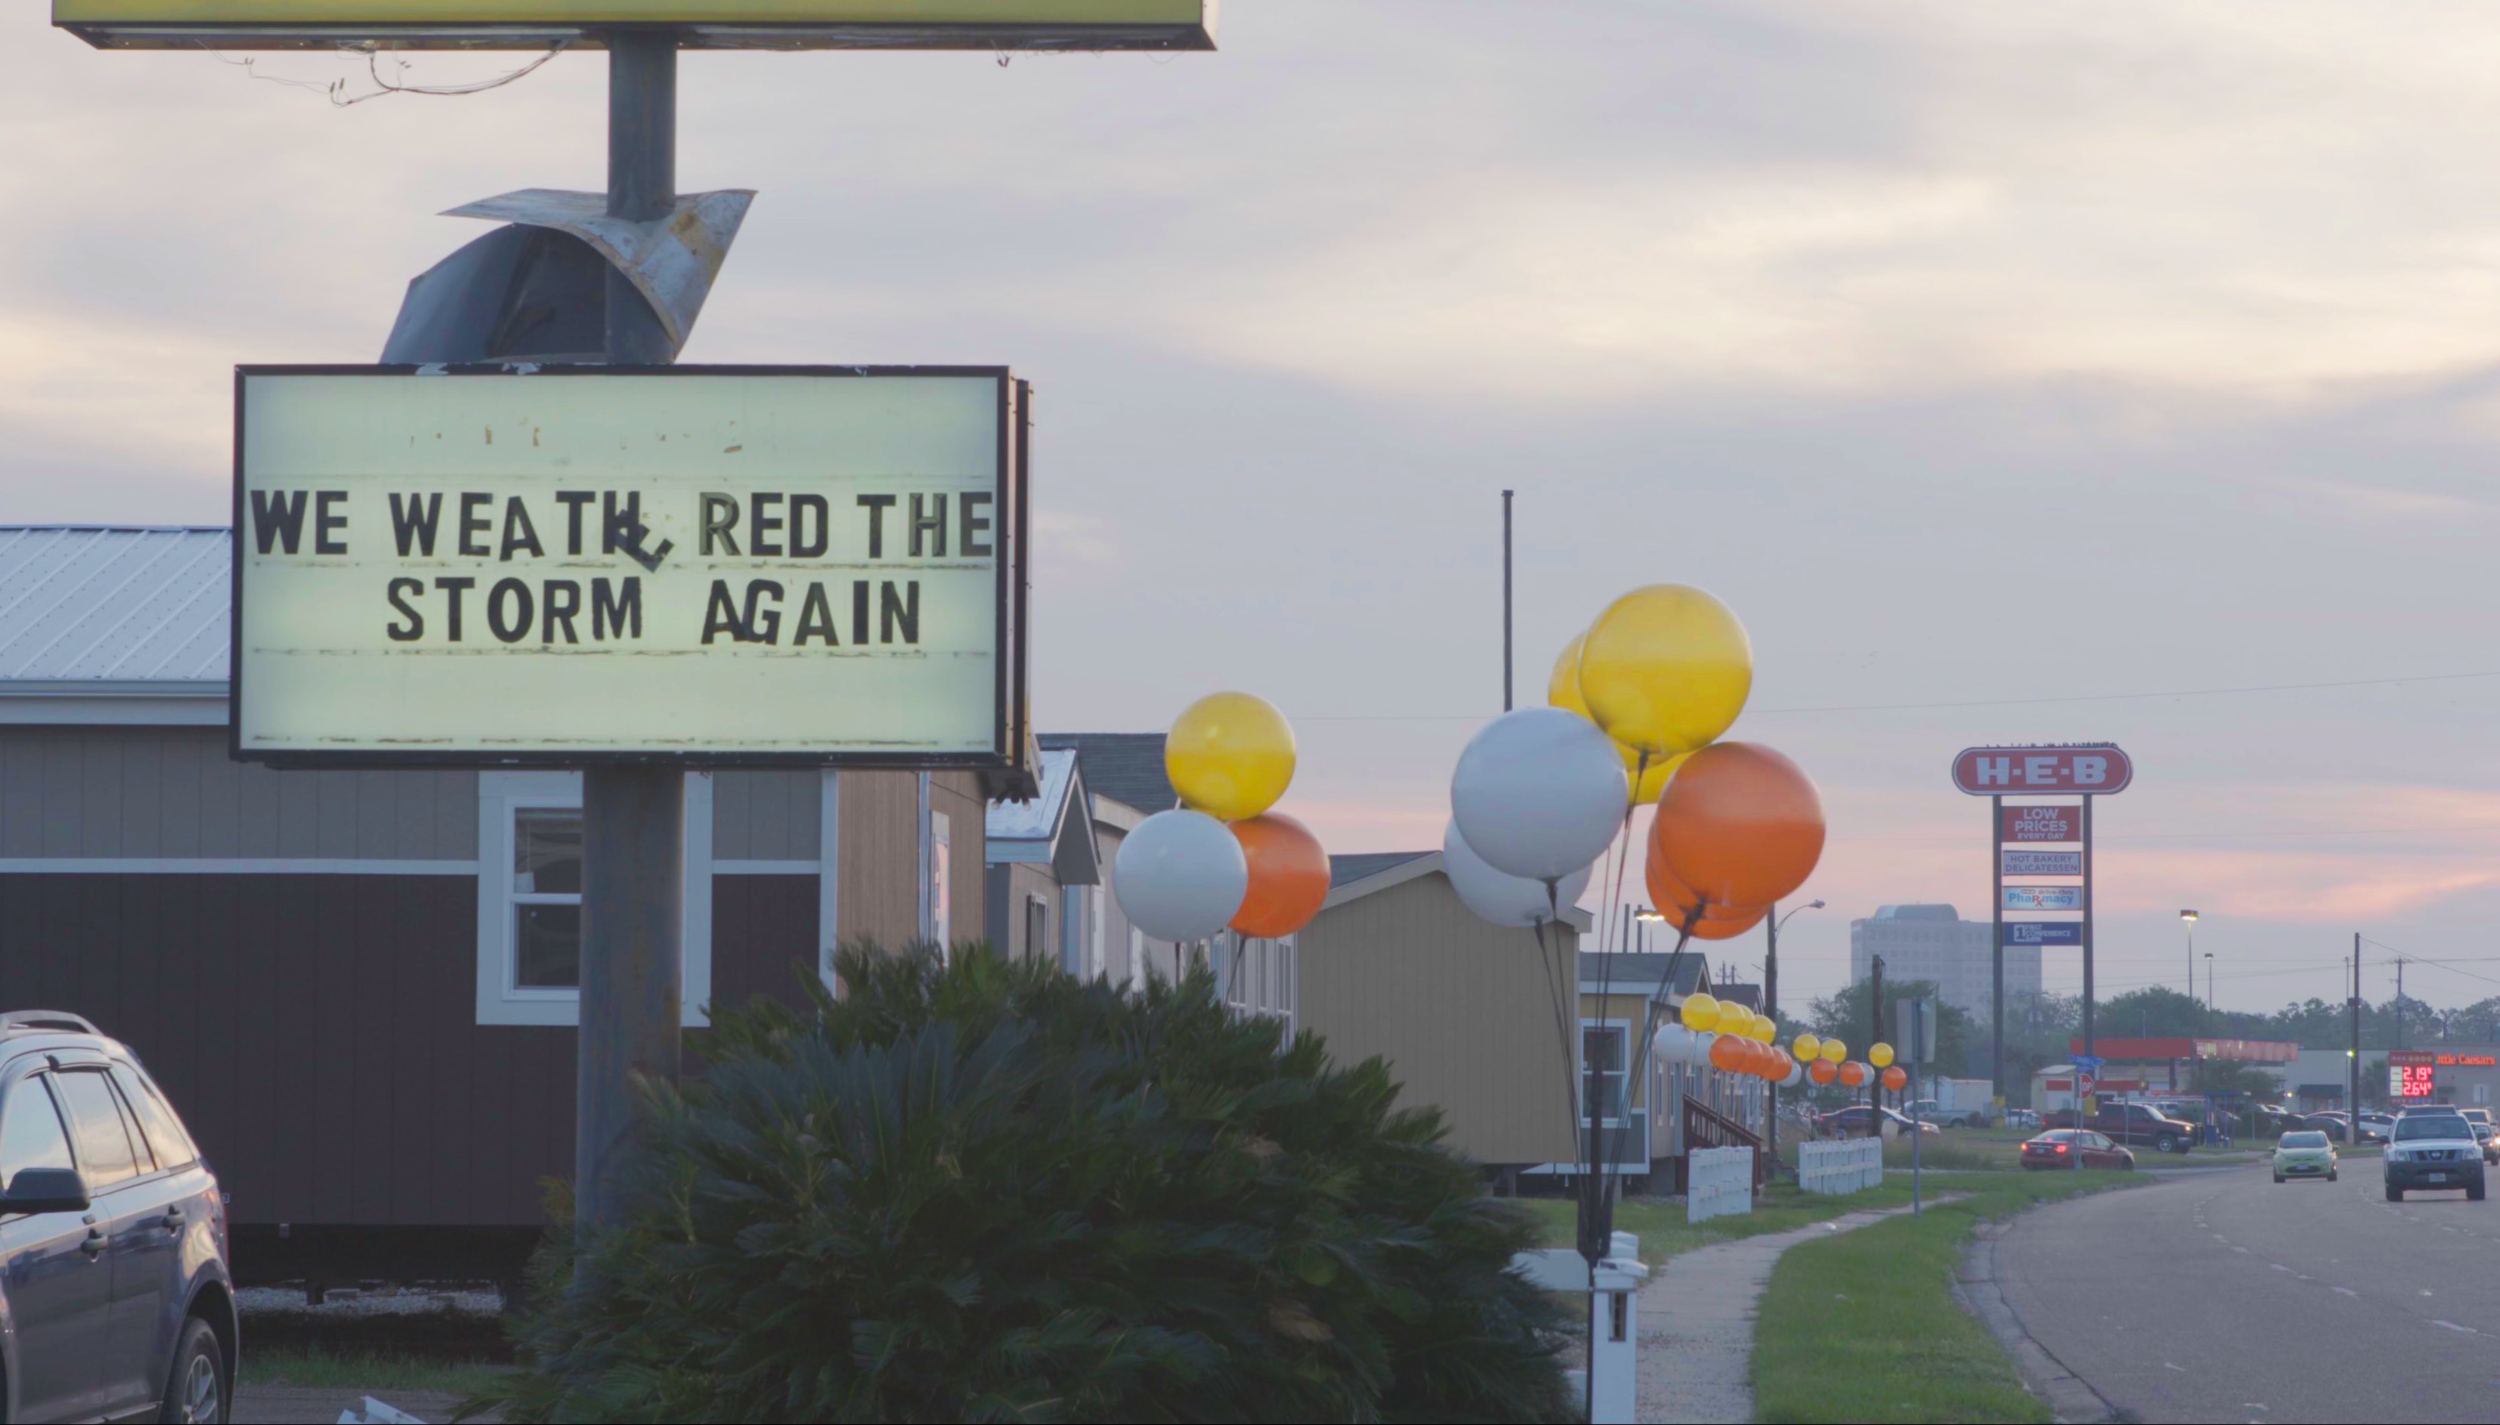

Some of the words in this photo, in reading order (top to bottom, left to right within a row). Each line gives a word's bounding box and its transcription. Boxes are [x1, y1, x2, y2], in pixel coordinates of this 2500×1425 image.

[250, 490, 348, 555] WE
[856, 491, 993, 559] THE
[387, 576, 642, 644] STORM
[700, 578, 920, 647] AGAIN
[2023, 808, 2059, 820] LOW
[2014, 820, 2068, 832] PRICES
[2010, 855, 2031, 863] HOT
[2033, 855, 2073, 863] BAKERY
[2005, 864, 2078, 873] DELICATESSEN
